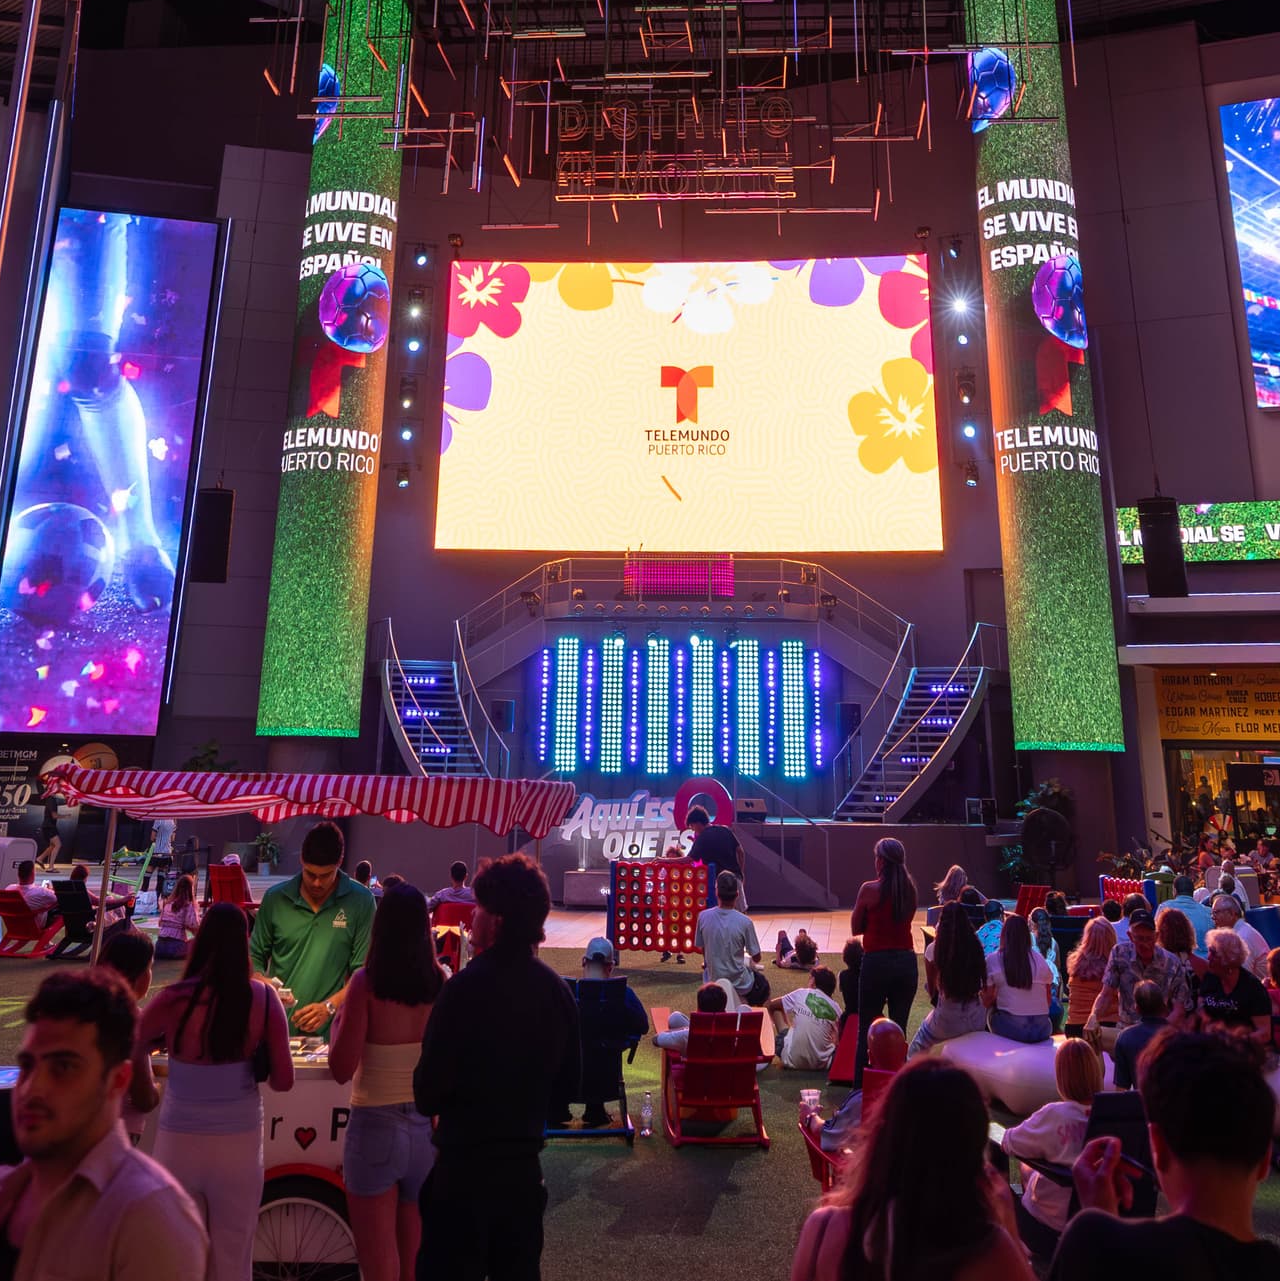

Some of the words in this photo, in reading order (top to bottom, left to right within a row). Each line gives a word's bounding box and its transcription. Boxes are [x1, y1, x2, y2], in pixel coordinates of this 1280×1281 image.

[310, 190, 397, 221] MUNDIAL
[977, 188, 995, 211] EL
[314, 221, 368, 243] VIVE
[370, 227, 393, 251] EN
[983, 215, 1007, 240] SE
[1009, 210, 1067, 234] VIVE
[1067, 215, 1079, 241] E
[645, 429, 730, 442] TELEMUNDO
[996, 424, 1099, 452] TELEMUND
[648, 444, 693, 456] PUERTO
[697, 444, 726, 456] RICO
[337, 452, 375, 475] RICO
[1000, 450, 1075, 475] PUERTO
[1079, 452, 1101, 477] RIC
[1220, 525, 1245, 542] SE
[1161, 675, 1190, 686] HIRAM
[1165, 707, 1195, 718] EDGAR
[1235, 723, 1259, 734] FLOR
[643, 799, 675, 829] ES
[602, 831, 662, 861] QUE
